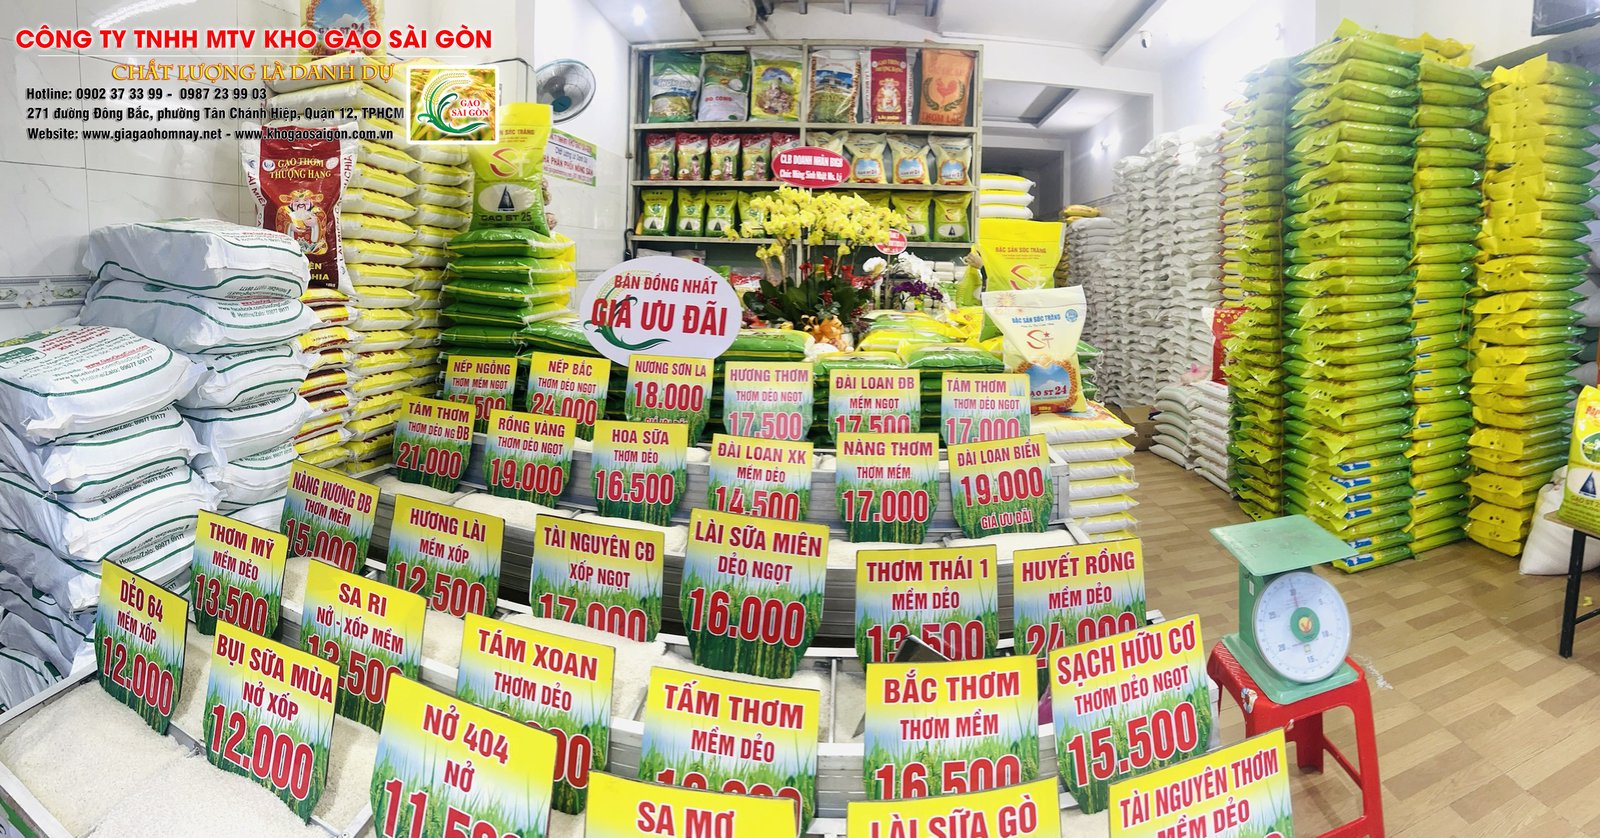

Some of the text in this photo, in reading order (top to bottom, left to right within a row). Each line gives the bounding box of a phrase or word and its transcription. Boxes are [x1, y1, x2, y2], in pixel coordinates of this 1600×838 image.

[521, 212, 532, 221] 25
[614, 273, 640, 290] BÁN
[682, 275, 717, 295] NHẤT
[592, 295, 727, 336] GIÁ ƯU ĐÃI
[454, 358, 472, 373] NẾP
[549, 358, 592, 377] NẾP BẮC
[635, 360, 707, 377] NƯƠNG SƠN LA
[730, 367, 809, 382] HƯƠNG THƠM
[836, 375, 915, 390] ĐÀI LOAN ĐB
[634, 380, 704, 412] 18.000
[947, 378, 1006, 393] TÁM THƠM
[1055, 385, 1067, 395] 24
[409, 401, 469, 423] TÁM THƠM
[534, 420, 565, 438] VÀNG
[612, 429, 669, 445] HOA SỮA
[718, 441, 807, 465] ĐÀI LOAN XK
[843, 439, 933, 456] NÀNG THƠM
[396, 441, 462, 479] 21.000
[957, 451, 977, 467] ĐÀI
[981, 447, 1010, 463] LOAN
[293, 471, 373, 514] NÀNG HƯƠNG ĐB
[490, 457, 563, 496] 19.000
[596, 469, 674, 505] 16.500
[960, 466, 1045, 508] 19.000
[842, 490, 929, 523] 17.000
[981, 508, 1032, 530] GIÁ ƯU ĐÃI
[209, 522, 248, 551] THƠM
[251, 537, 275, 560] MỸ
[410, 508, 486, 542] HƯƠNG LÀI
[695, 519, 822, 557] LÀI SỮA MIÊN
[544, 525, 655, 562] TÀI NGUYÊN CĐ
[866, 556, 988, 582] THƠM THÁI 1
[1022, 548, 1135, 582] HUYẾT RỒNG
[120, 577, 163, 622] DẺO 64
[339, 582, 387, 617] SA RI
[689, 586, 806, 648] 16.000
[216, 633, 334, 704] BỤI SỮA MÙA
[478, 628, 598, 681] TÁM XOAN
[1057, 621, 1197, 687] SẠCH HỮU CƠ
[103, 635, 174, 717] 12.000
[884, 669, 1020, 705] BẮC THƠM
[664, 680, 804, 730] TẤM THƠM
[211, 703, 314, 801] 12.000
[423, 704, 510, 765] NỞ 404
[1067, 702, 1198, 788] 15.500
[1120, 748, 1279, 829] TÀI NGUYÊN THƠM
[637, 801, 736, 838] SA MƠ
